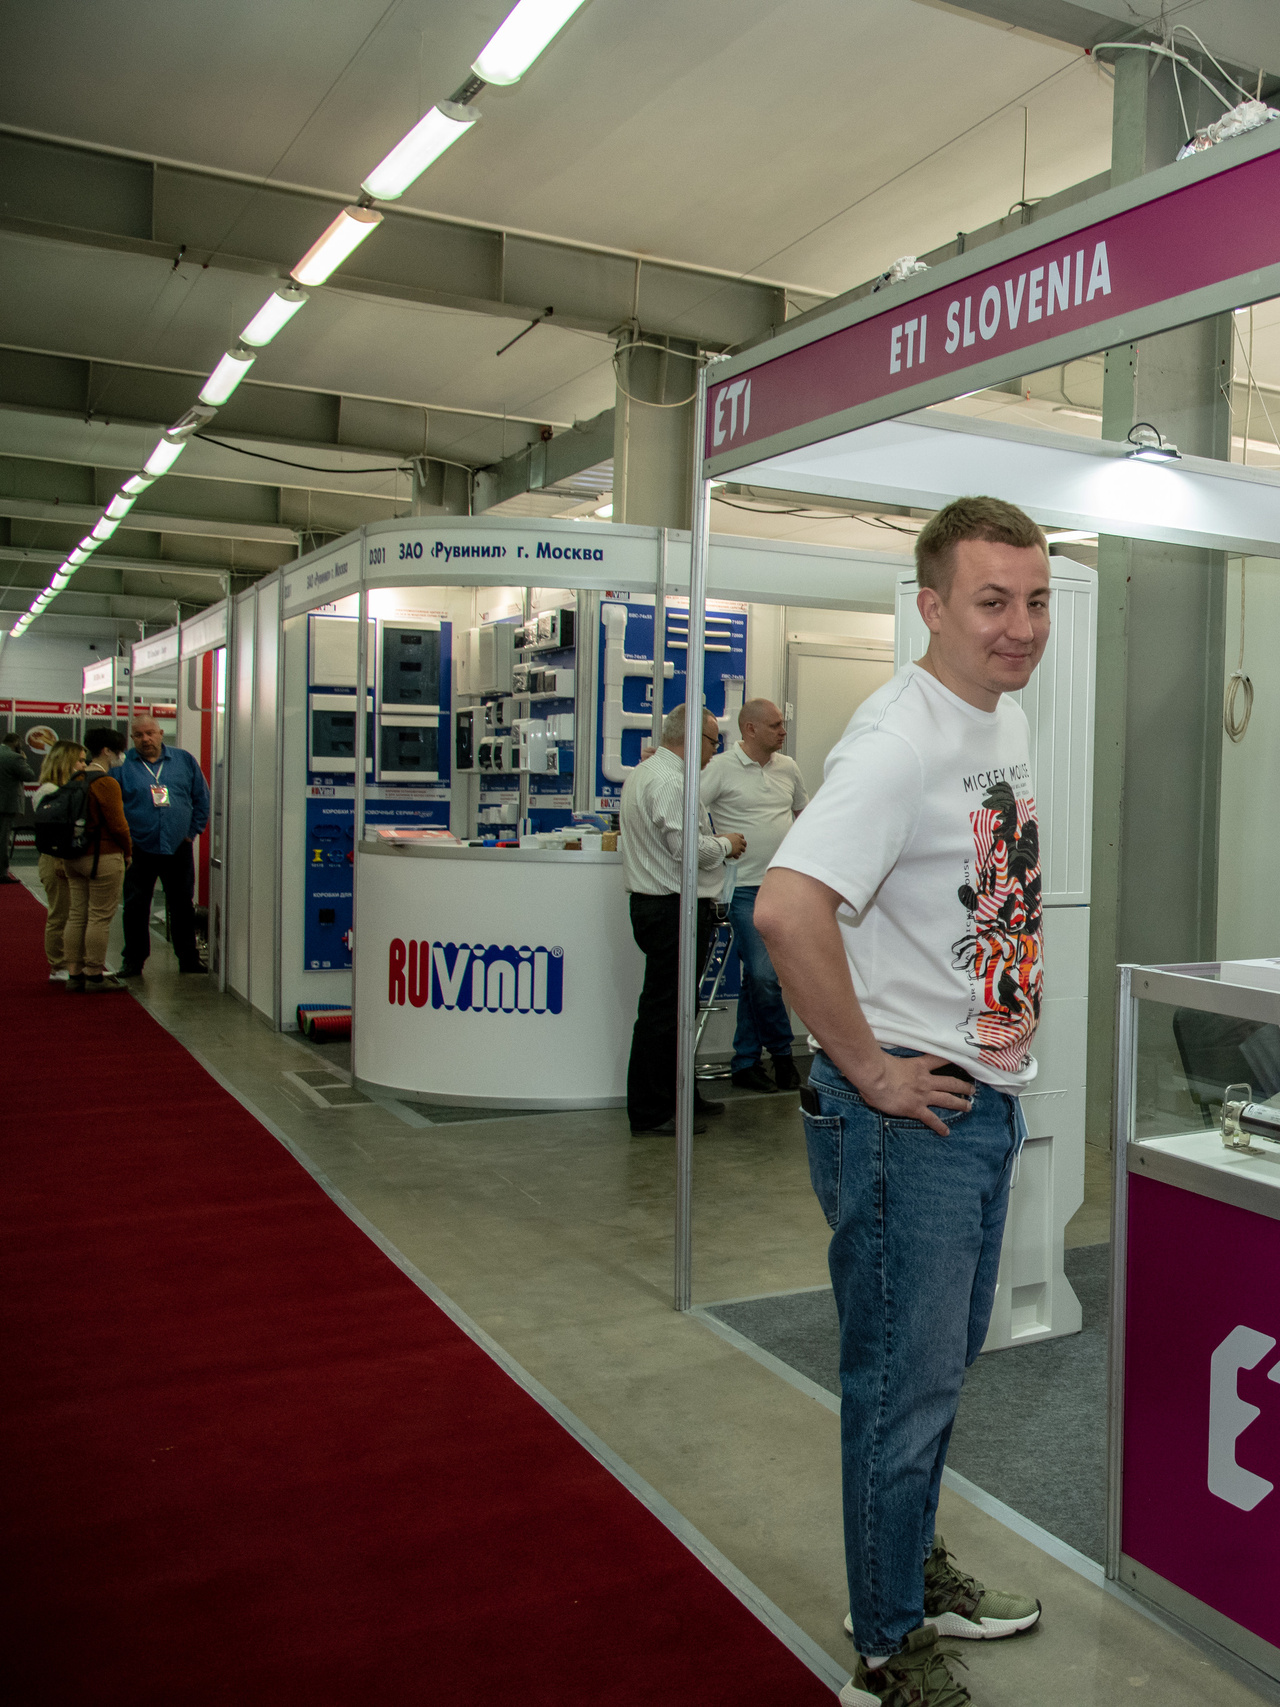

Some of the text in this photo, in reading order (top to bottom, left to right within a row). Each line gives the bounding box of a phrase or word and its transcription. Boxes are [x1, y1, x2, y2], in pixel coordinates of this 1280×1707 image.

[890, 240, 1112, 375] ETI SLOVENIA
[713, 378, 752, 448] ETI
[369, 547, 386, 566] D301
[398, 541, 424, 561] ЗАО
[517, 546, 530, 560] г.
[535, 541, 604, 562] Москва
[962, 768, 1005, 793] MICKEY
[963, 858, 971, 885] OUSE
